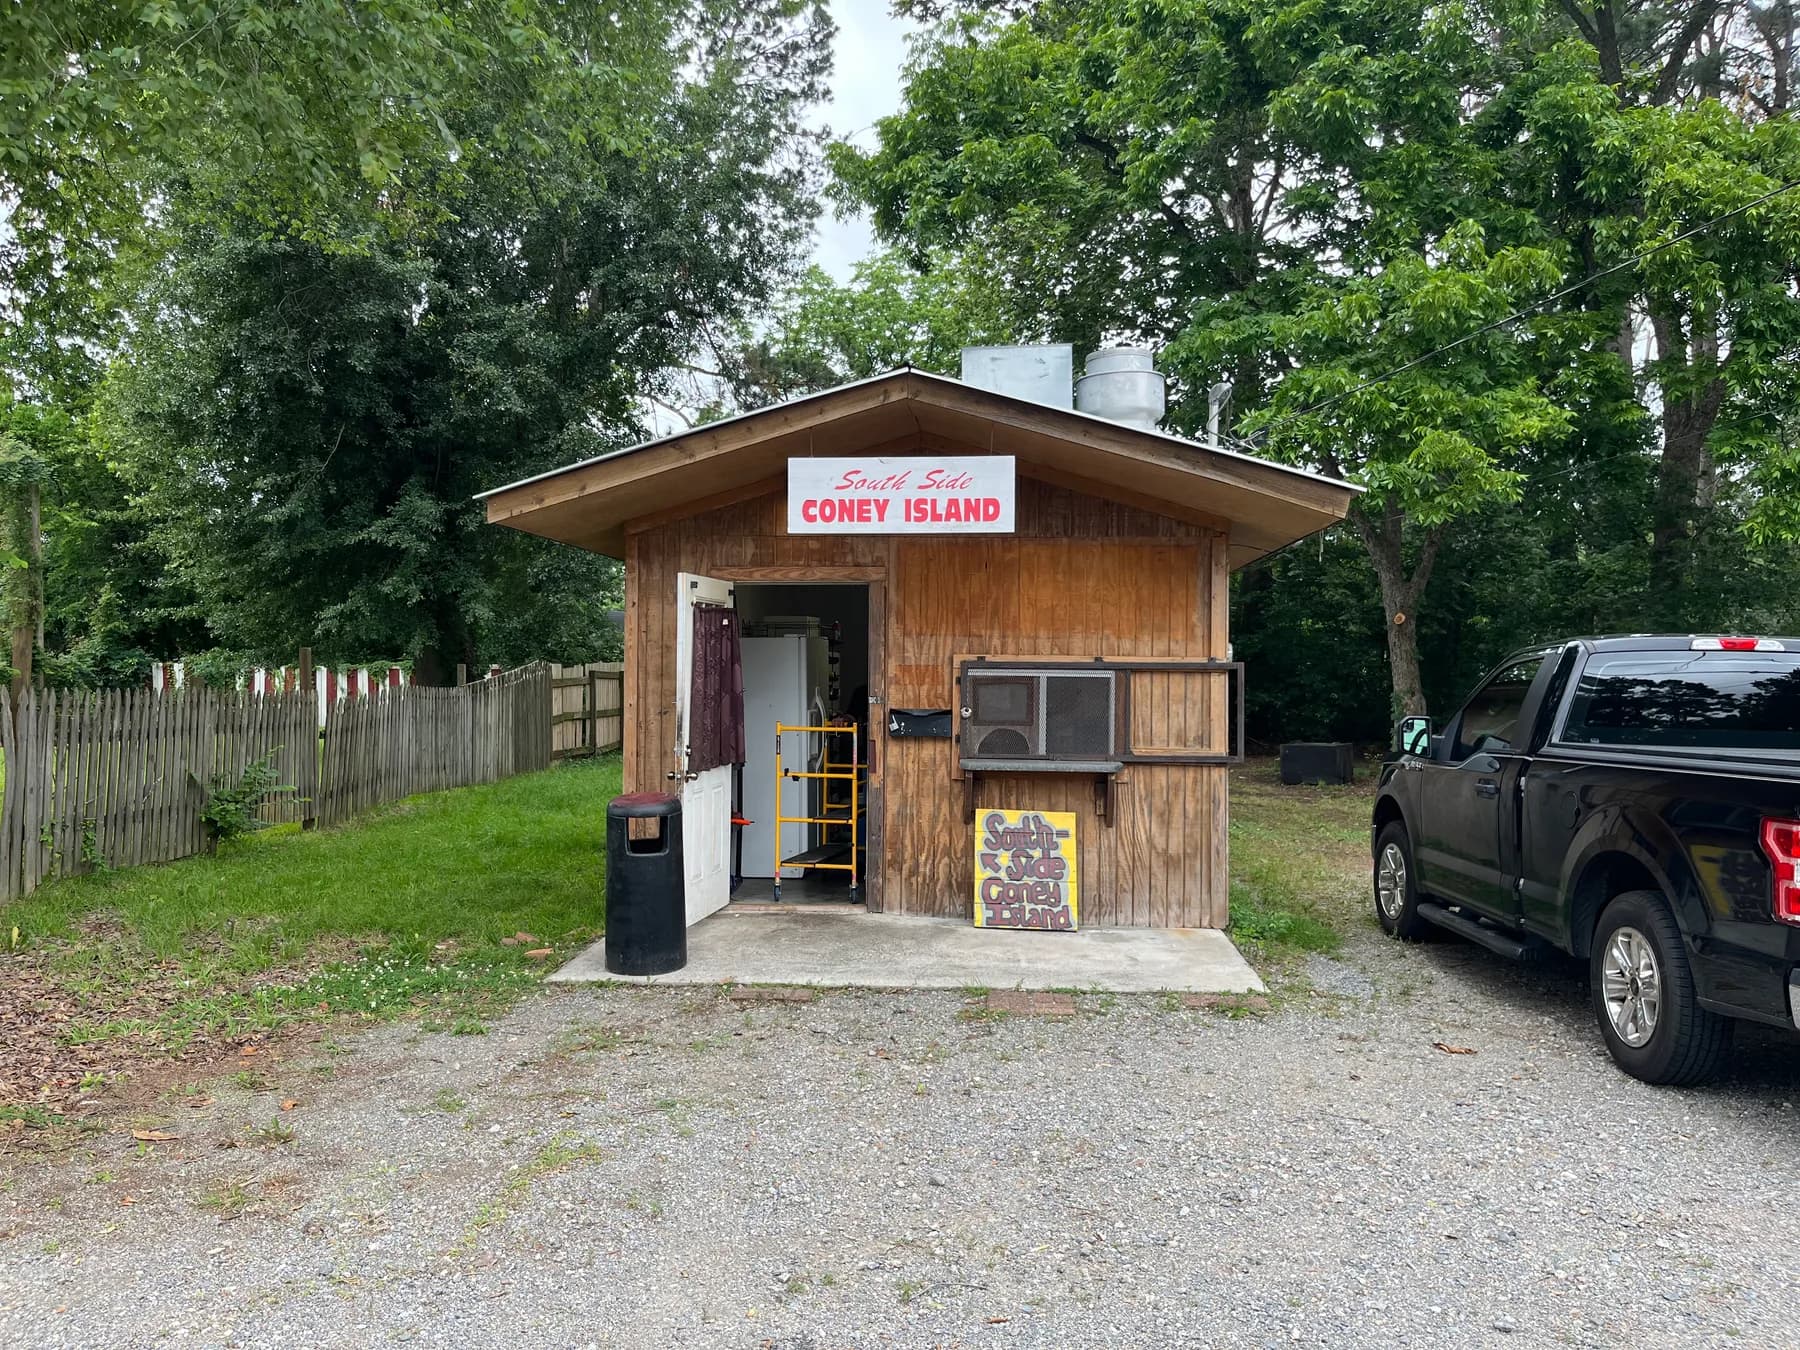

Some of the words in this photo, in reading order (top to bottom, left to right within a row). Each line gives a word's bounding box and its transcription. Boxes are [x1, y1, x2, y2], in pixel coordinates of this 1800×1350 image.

[833, 469, 912, 491] South
[917, 469, 974, 490] Side
[802, 498, 890, 523] CONEY
[904, 497, 1001, 523] ISLAND
[1006, 848, 1066, 880] Side
[981, 876, 1061, 908] Coney
[985, 903, 1073, 930] Island
